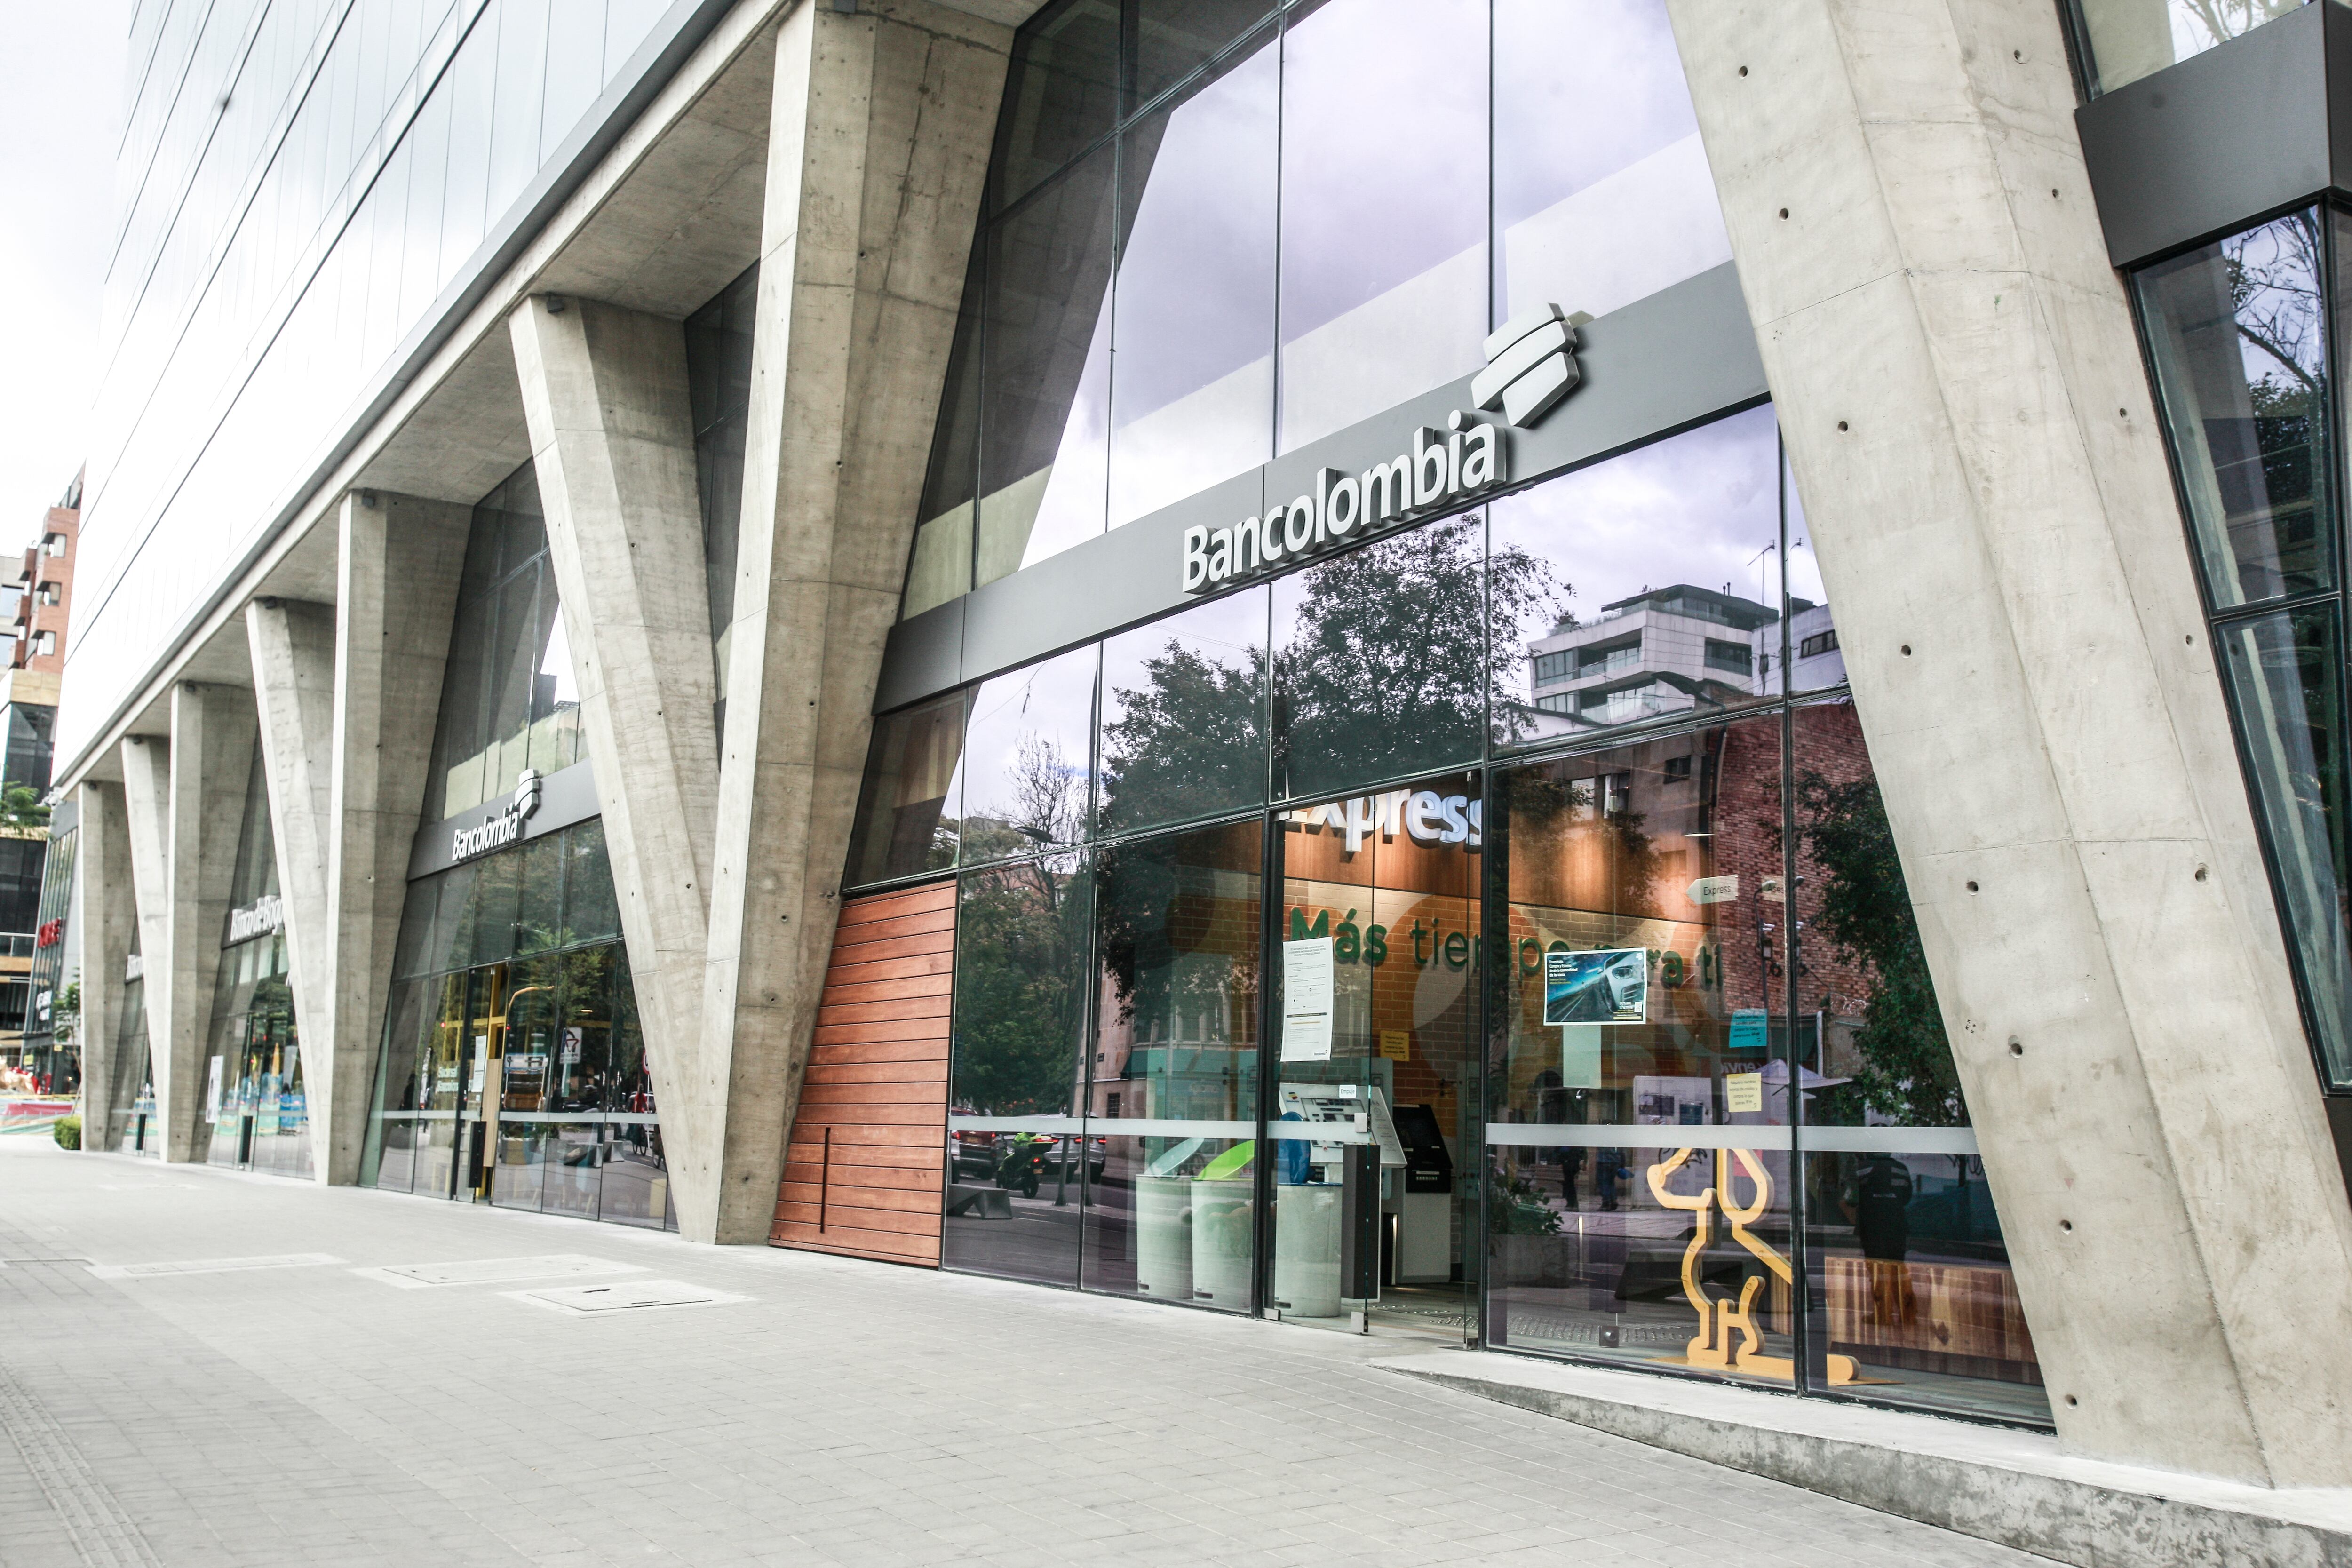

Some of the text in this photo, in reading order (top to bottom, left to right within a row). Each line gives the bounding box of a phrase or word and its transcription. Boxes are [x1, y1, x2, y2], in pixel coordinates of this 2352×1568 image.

[1183, 409, 1497, 593] Bancolombia
[452, 803, 519, 861] Bancolombia
[1287, 788, 1481, 852] xpress
[230, 909, 253, 941] Banco
[263, 896, 284, 934] Bogo
[1703, 885, 1731, 895] Express
[1290, 908, 1387, 963] Más
[1411, 918, 1570, 979] tiep
